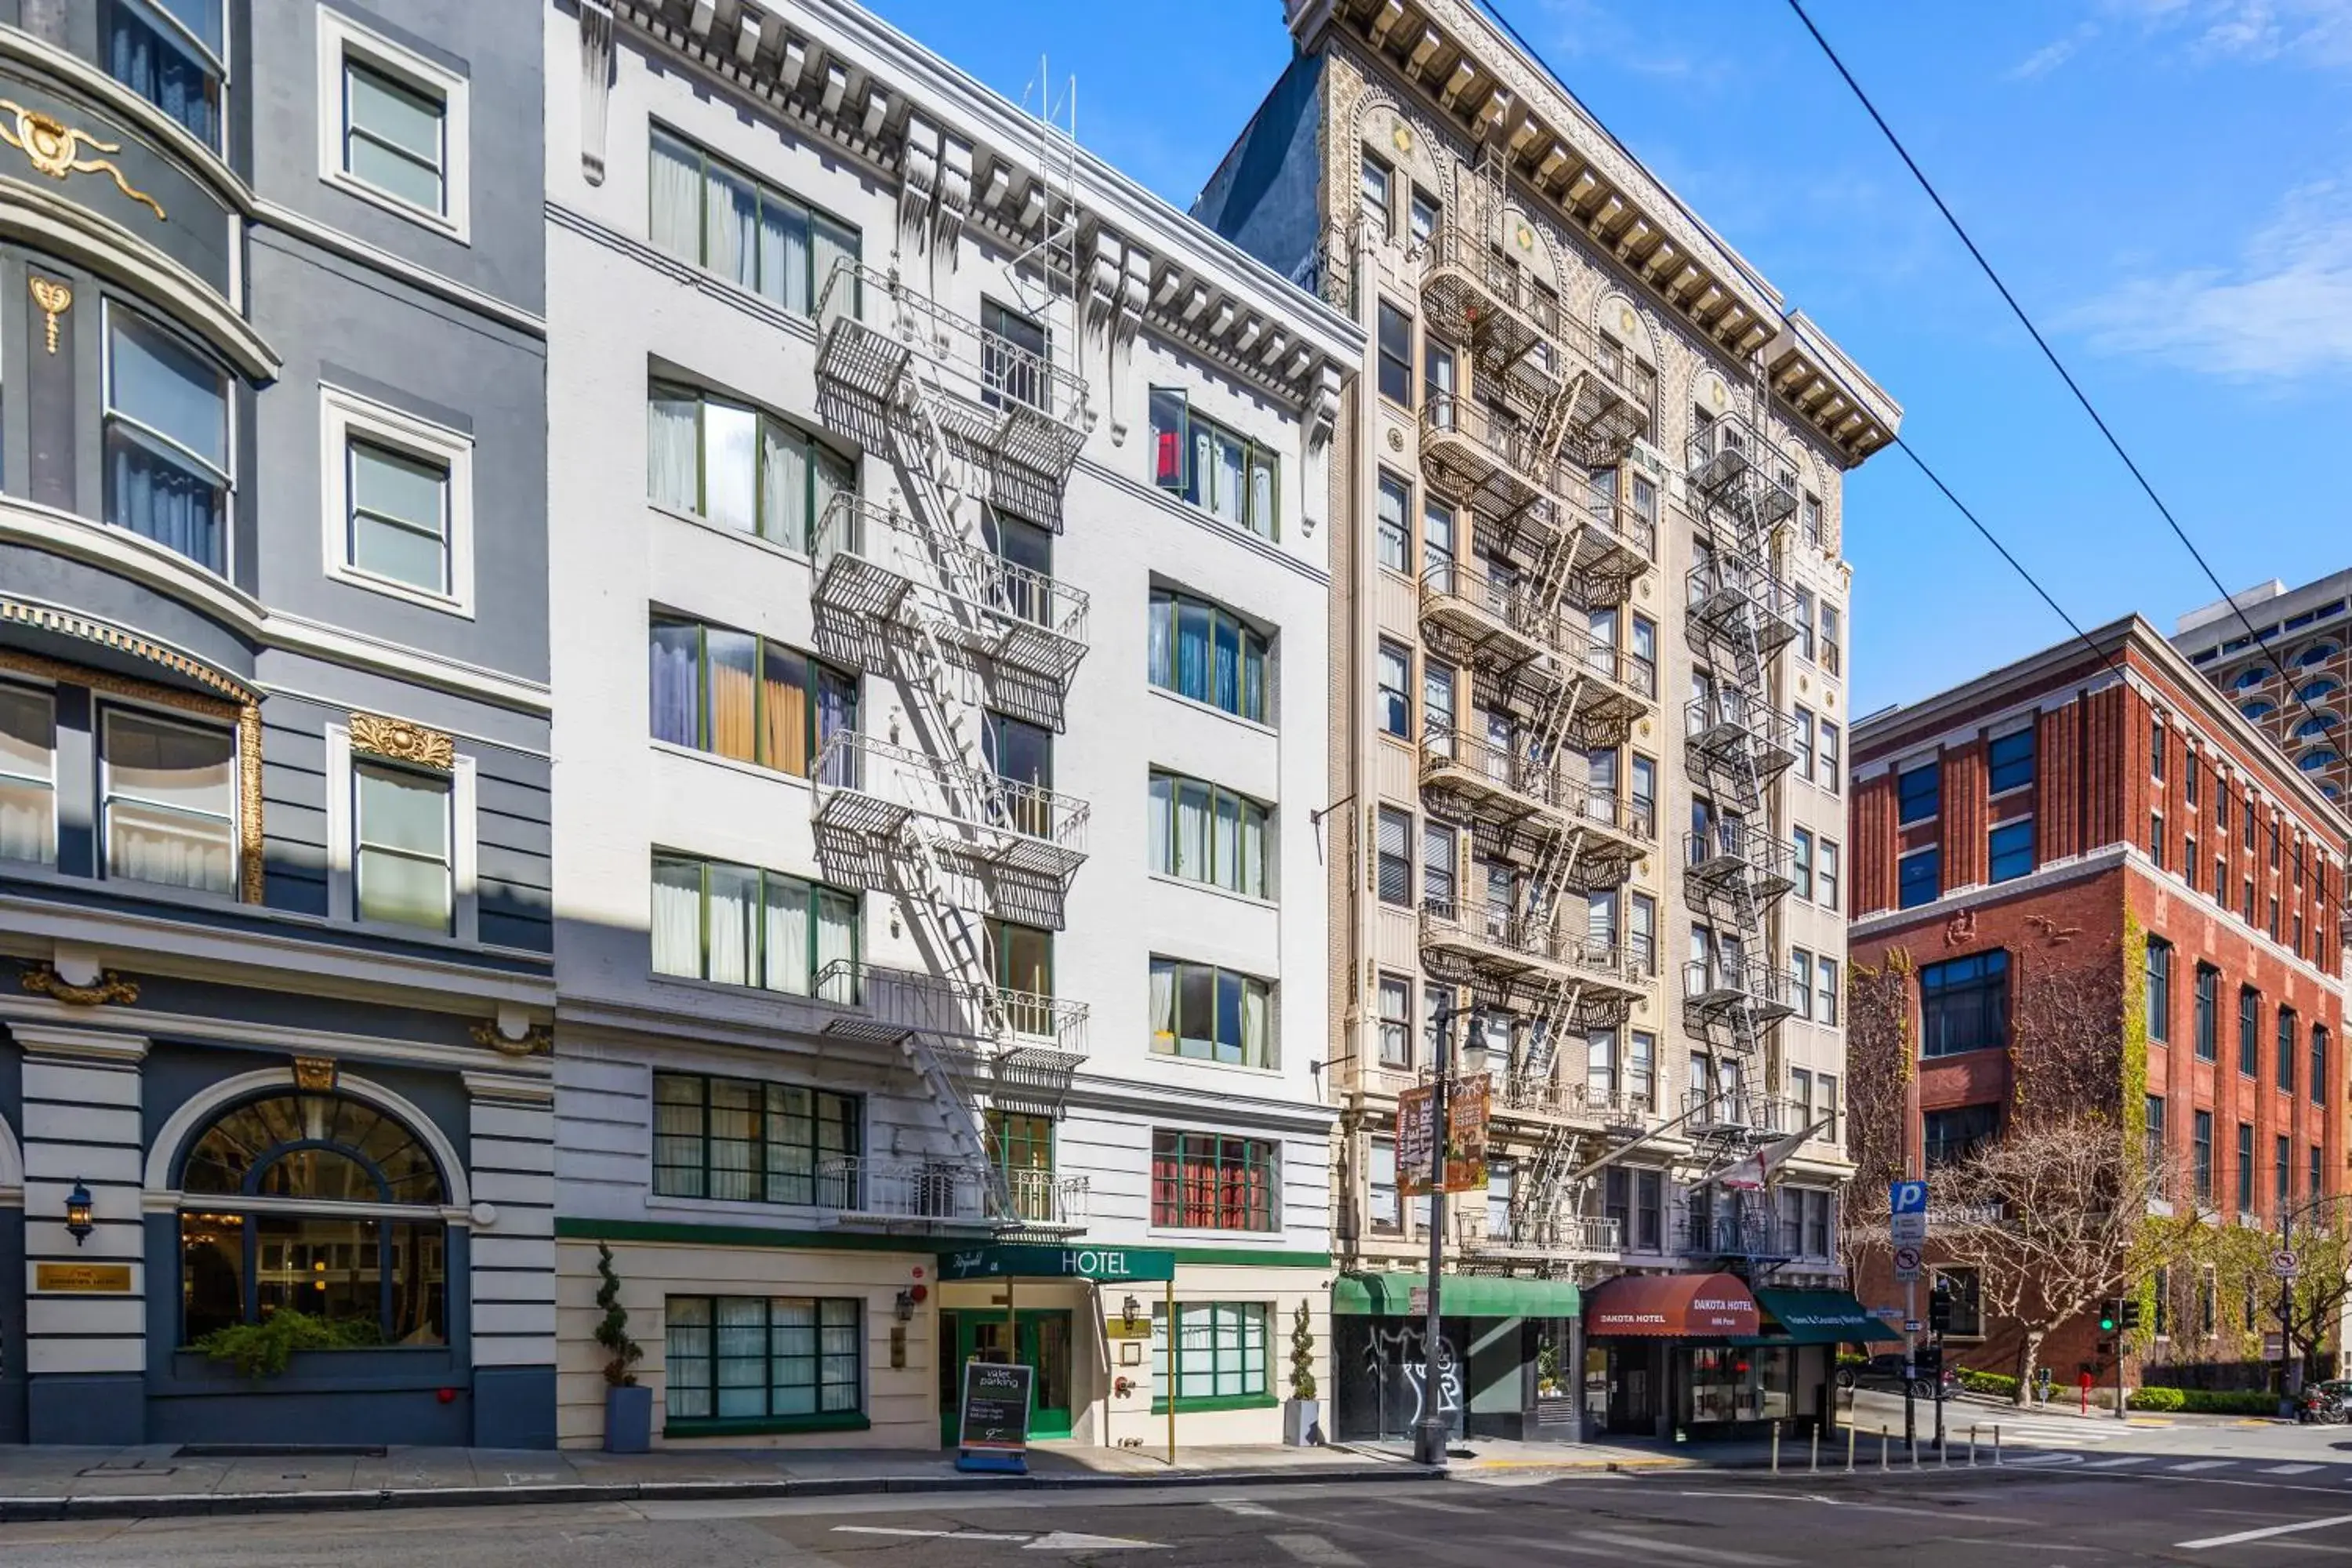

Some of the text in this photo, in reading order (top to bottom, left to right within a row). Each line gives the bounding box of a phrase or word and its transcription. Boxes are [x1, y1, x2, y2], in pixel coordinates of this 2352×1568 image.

[1420, 1098, 1434, 1178] NATURE
[1405, 1112, 1421, 1186] STATE OF
[1062, 1250, 1130, 1275] HOTEL
[1693, 1299, 1753, 1312] DAKOTA HOTEL
[1600, 1315, 1666, 1323] DAKOTA HOTEL
[980, 1377, 1018, 1388] parking
